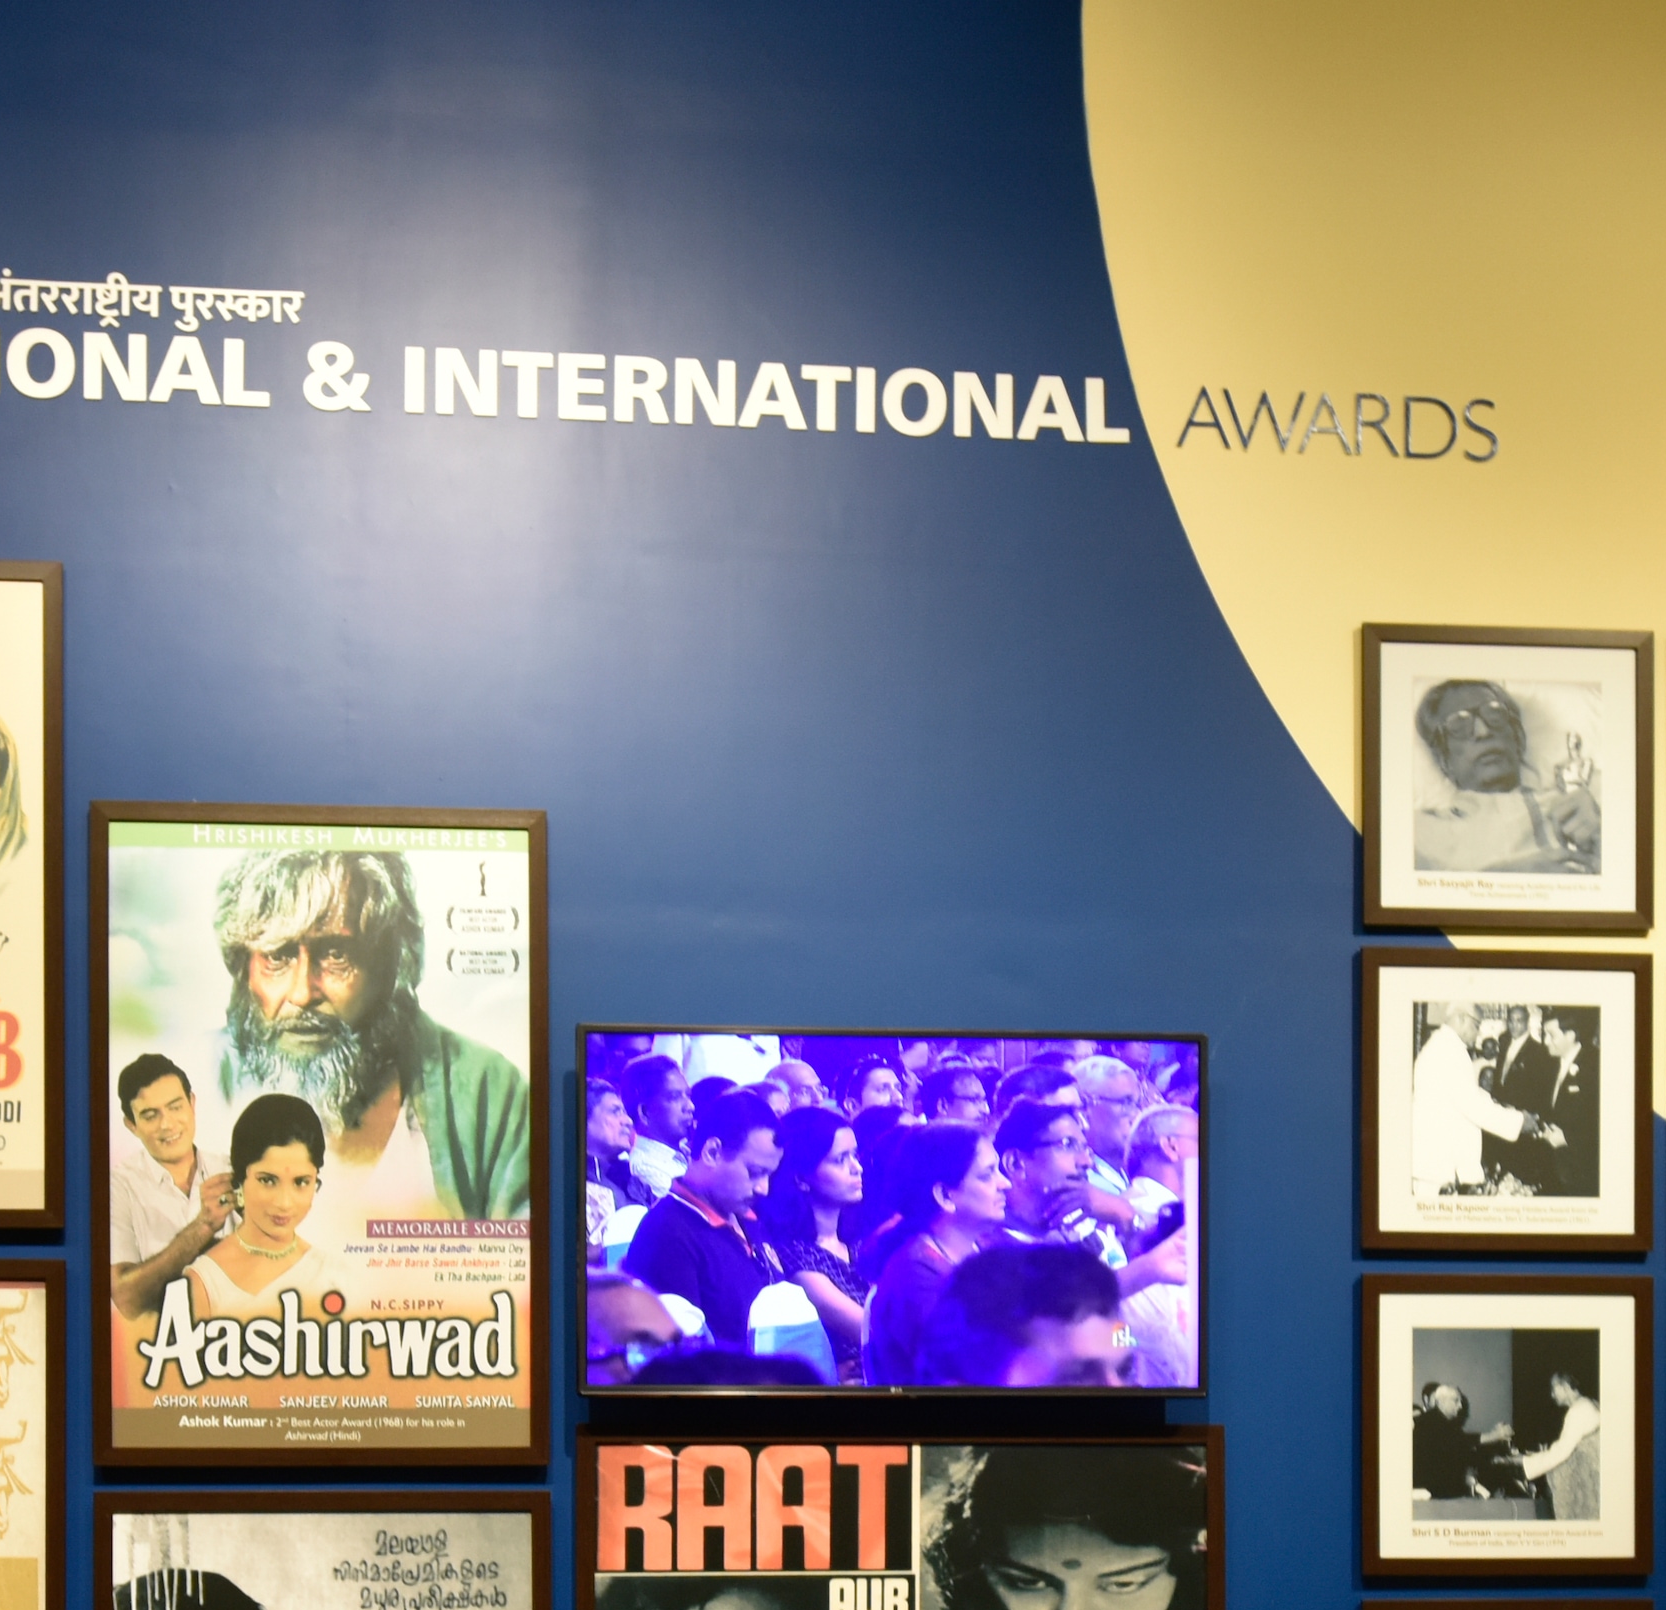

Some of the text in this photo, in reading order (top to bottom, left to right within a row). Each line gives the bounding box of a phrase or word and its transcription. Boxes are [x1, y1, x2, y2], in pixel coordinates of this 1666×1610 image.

[170, 285, 303, 332] पुरस्कार
[303, 340, 371, 412] &
[403, 345, 1131, 445] INTERNATIONAL
[1175, 385, 1500, 463] AWARDS
[193, 824, 508, 849] HRISHIKESH MUKHERJEE'S
[371, 1219, 528, 1236] MEMORABLE SONGS
[138, 1276, 518, 1389] Aashirwad
[153, 1395, 515, 1409] ASHOK KUMAR SANJEEV KUMAR SUMITA SANYAL
[178, 1414, 267, 1428] Ashok Kumar
[596, 1444, 909, 1571] RAAT
